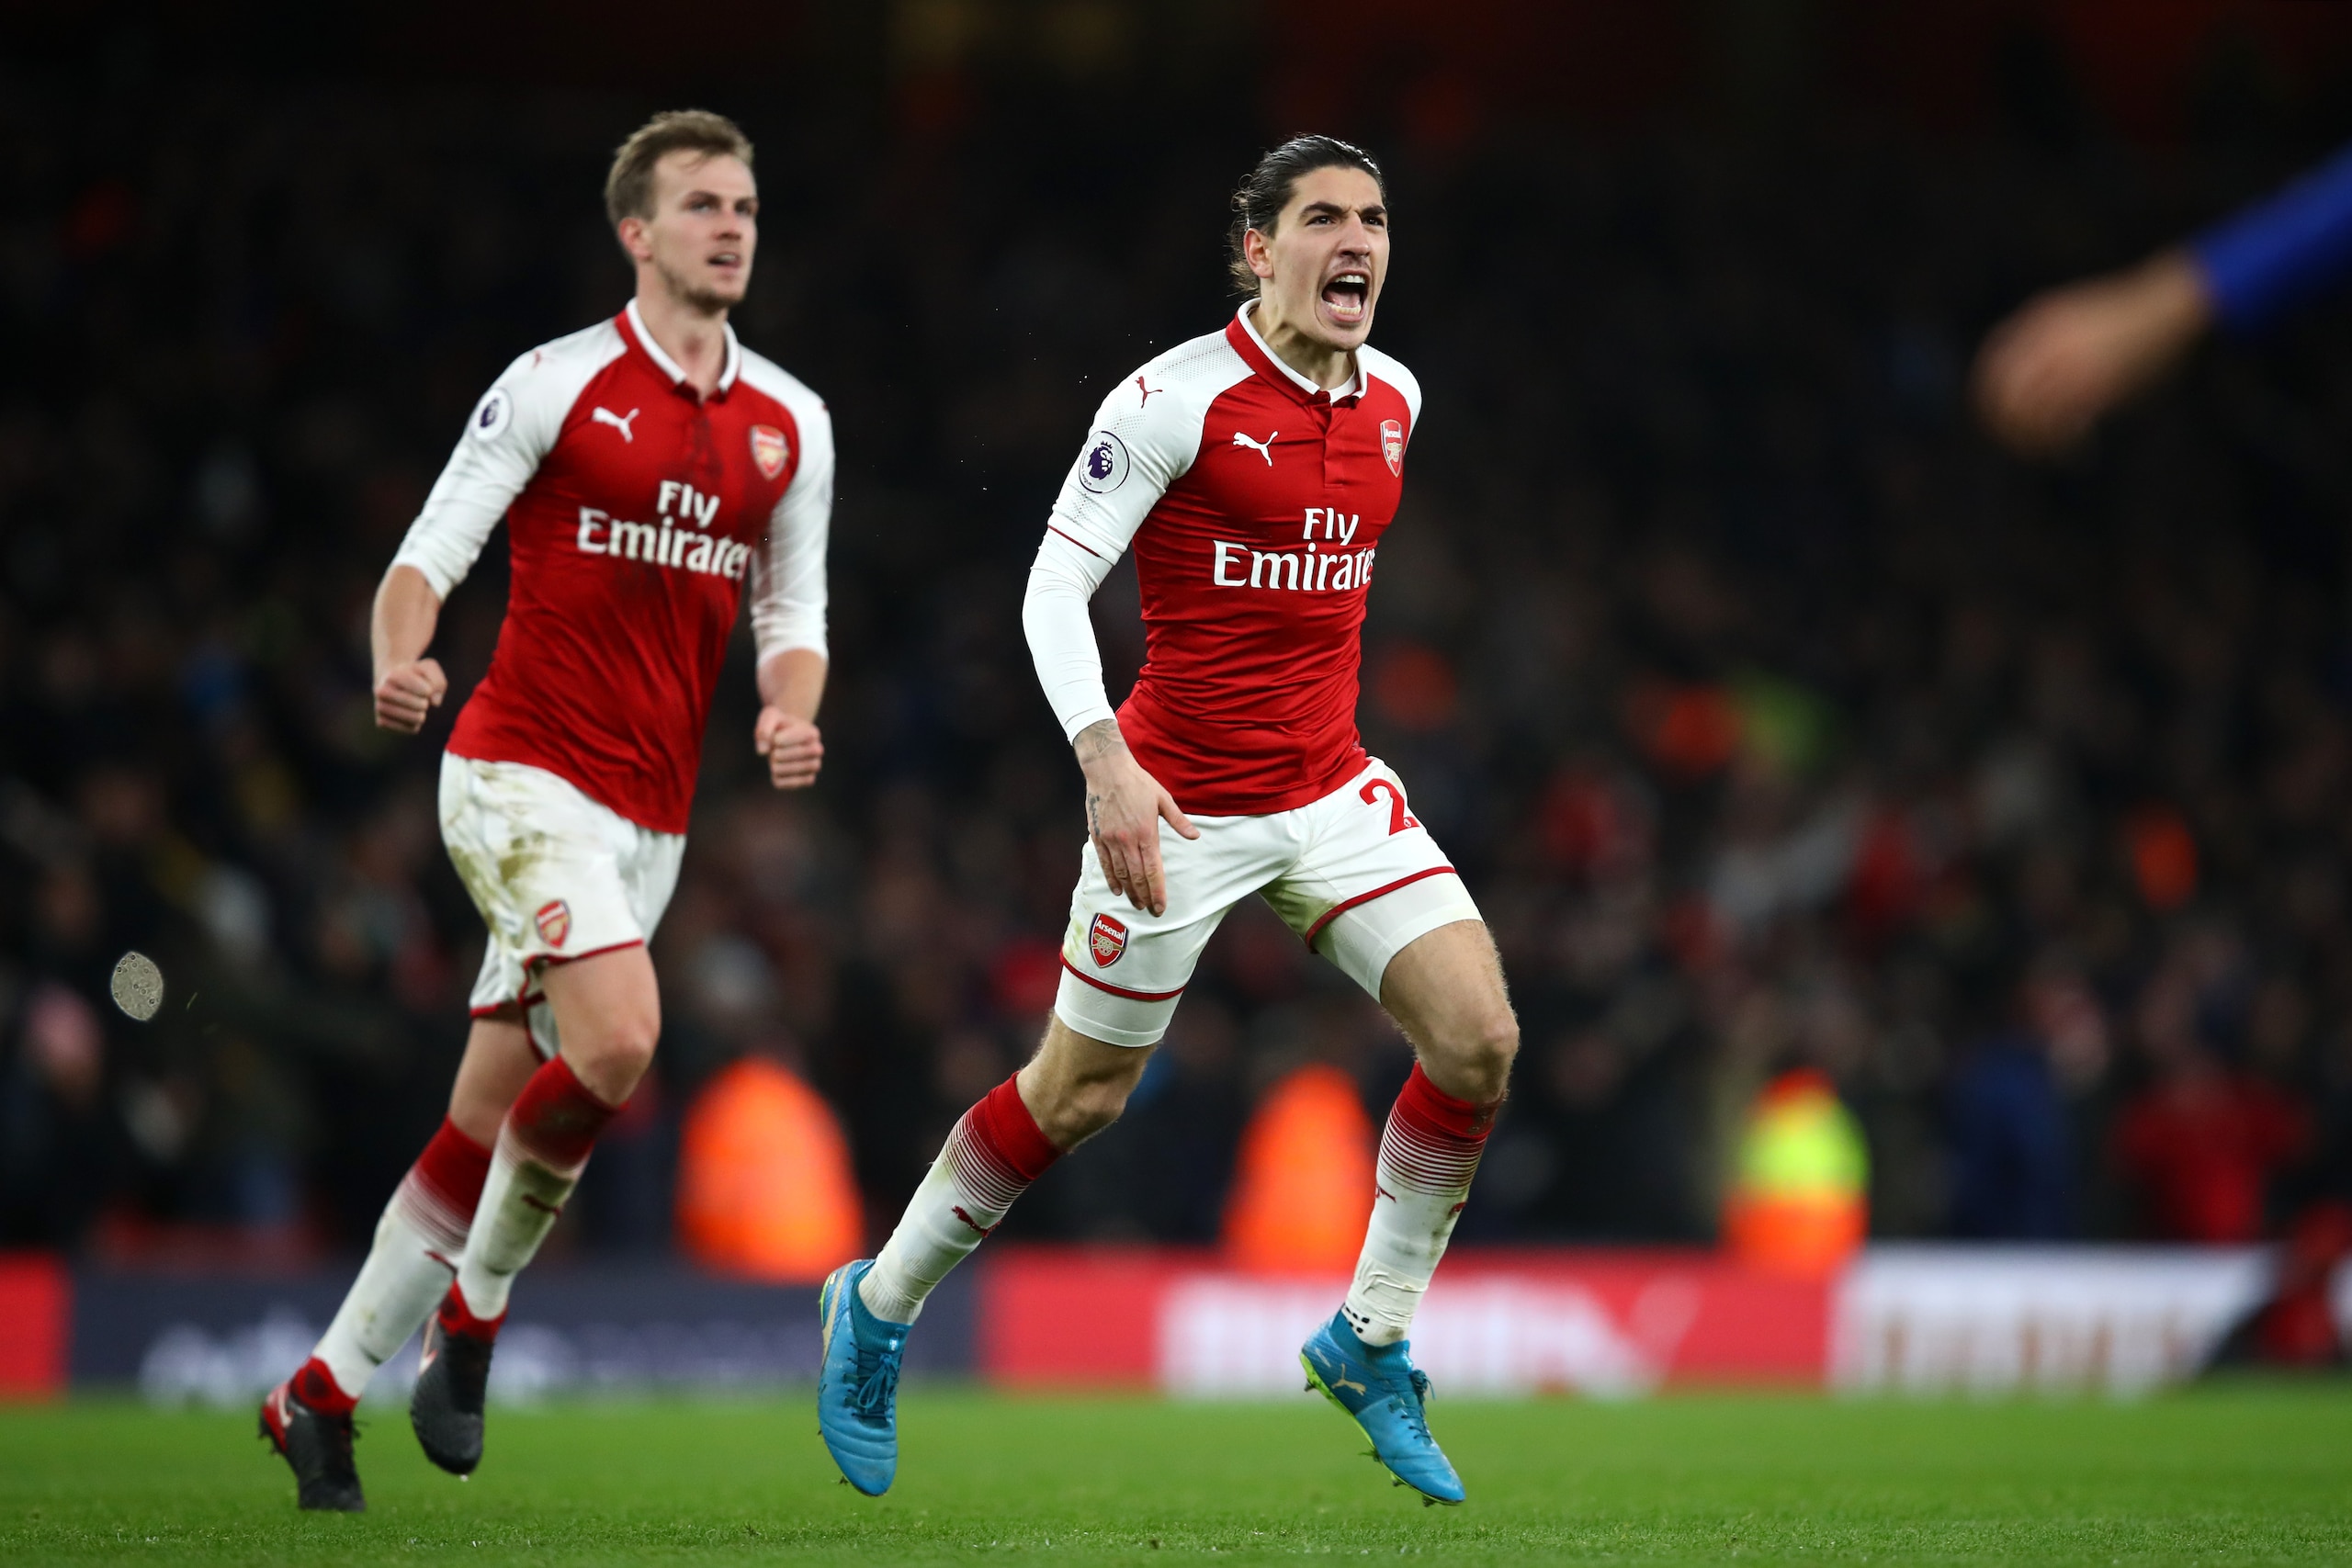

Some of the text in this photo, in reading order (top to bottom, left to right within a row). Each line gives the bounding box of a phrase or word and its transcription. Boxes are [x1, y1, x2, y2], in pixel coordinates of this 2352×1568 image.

[656, 480, 720, 528] Fly
[1303, 507, 1360, 546] Fly
[1096, 919, 1125, 941] Arsenal
